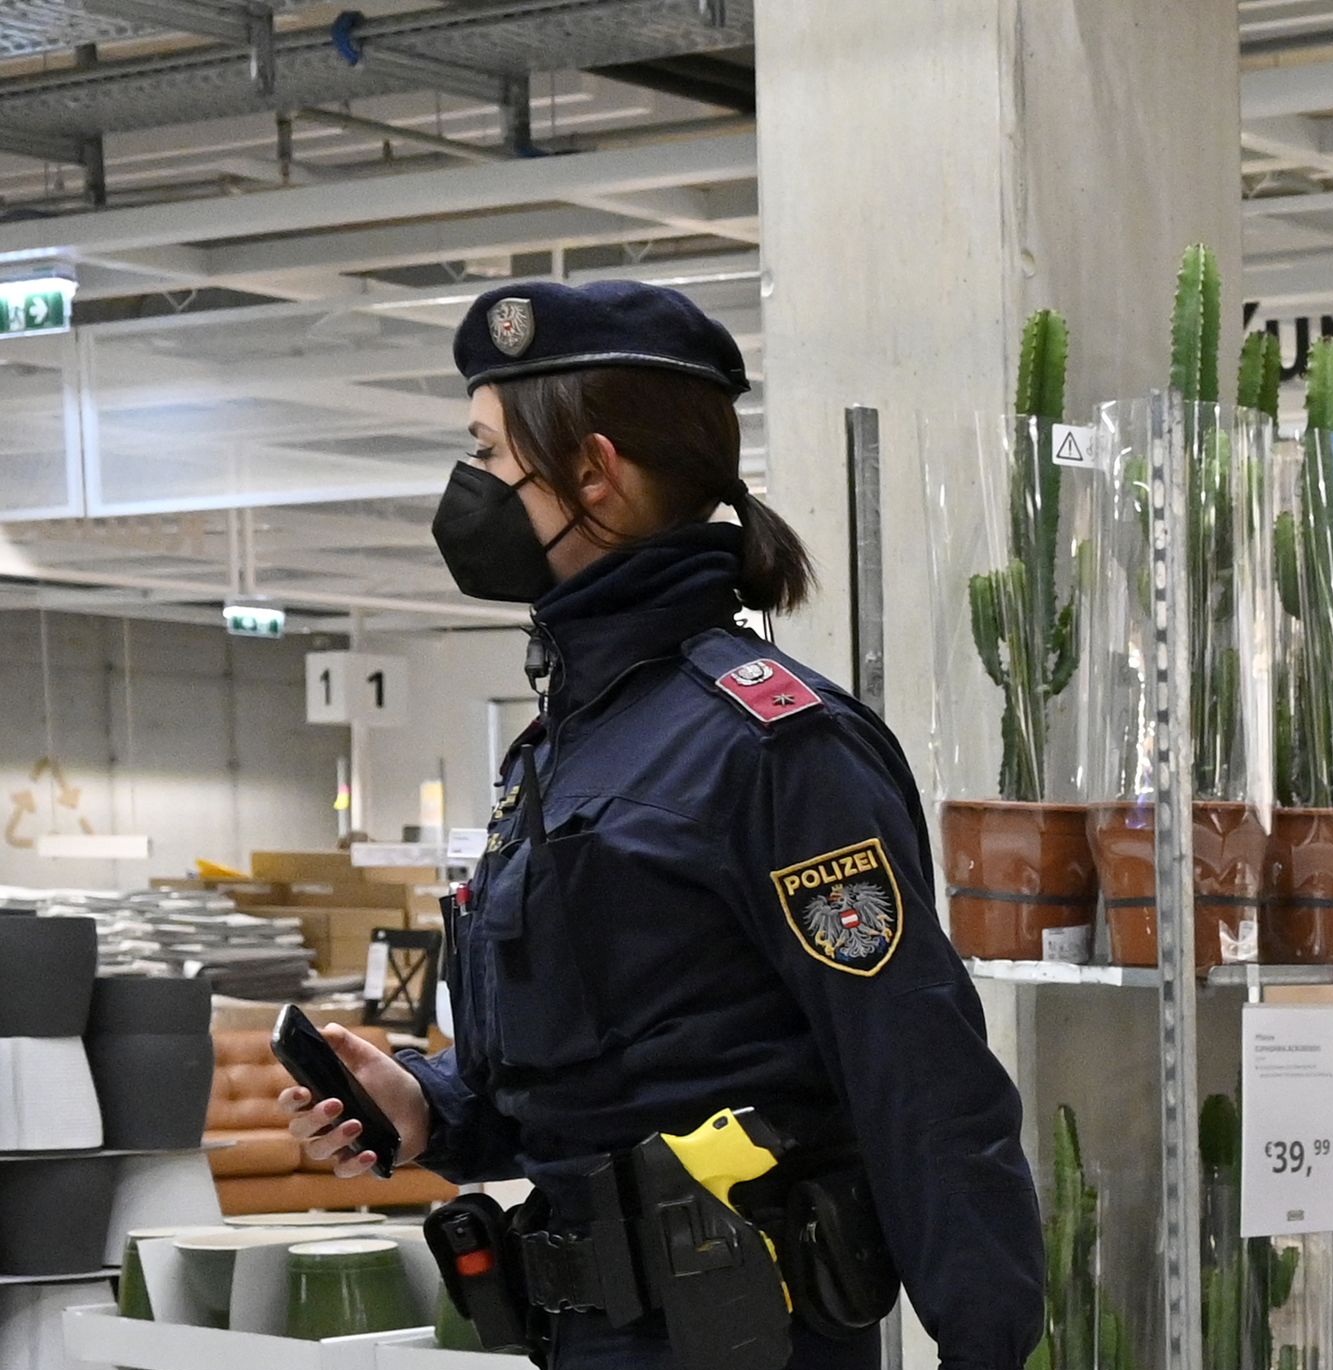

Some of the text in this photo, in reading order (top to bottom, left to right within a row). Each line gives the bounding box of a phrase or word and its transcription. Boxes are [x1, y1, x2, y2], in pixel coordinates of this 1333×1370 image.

[320, 670, 331, 706] 1
[367, 671, 385, 708] 1
[782, 849, 879, 896] POLIZEI
